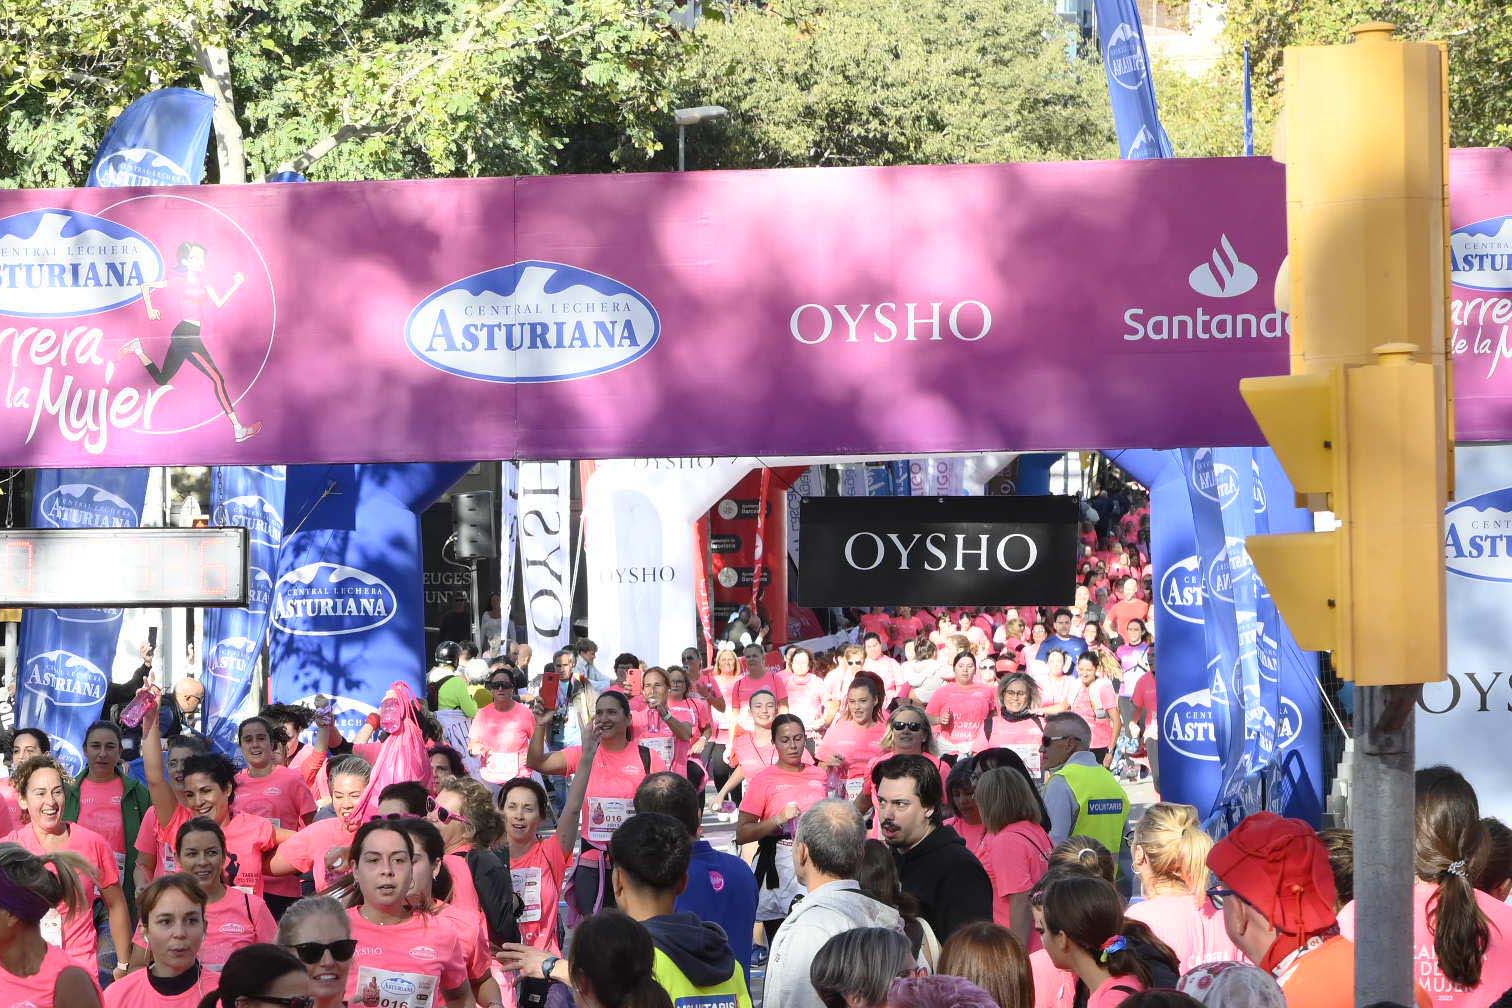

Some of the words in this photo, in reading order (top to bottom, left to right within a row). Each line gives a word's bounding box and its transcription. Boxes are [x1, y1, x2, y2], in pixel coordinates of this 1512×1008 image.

[65, 244, 140, 256] LECHERA
[464, 303, 543, 317] CENTRAL
[551, 300, 631, 315] LECHERA
[789, 301, 992, 345] OYSHO
[1123, 307, 1291, 341] Santand
[425, 310, 641, 352] ASTURIANA
[1473, 327, 1492, 355] la
[5, 370, 30, 409] la
[24, 353, 174, 454] Mujer
[843, 531, 1039, 574] OYSHO
[274, 590, 388, 620] ASTURIANA
